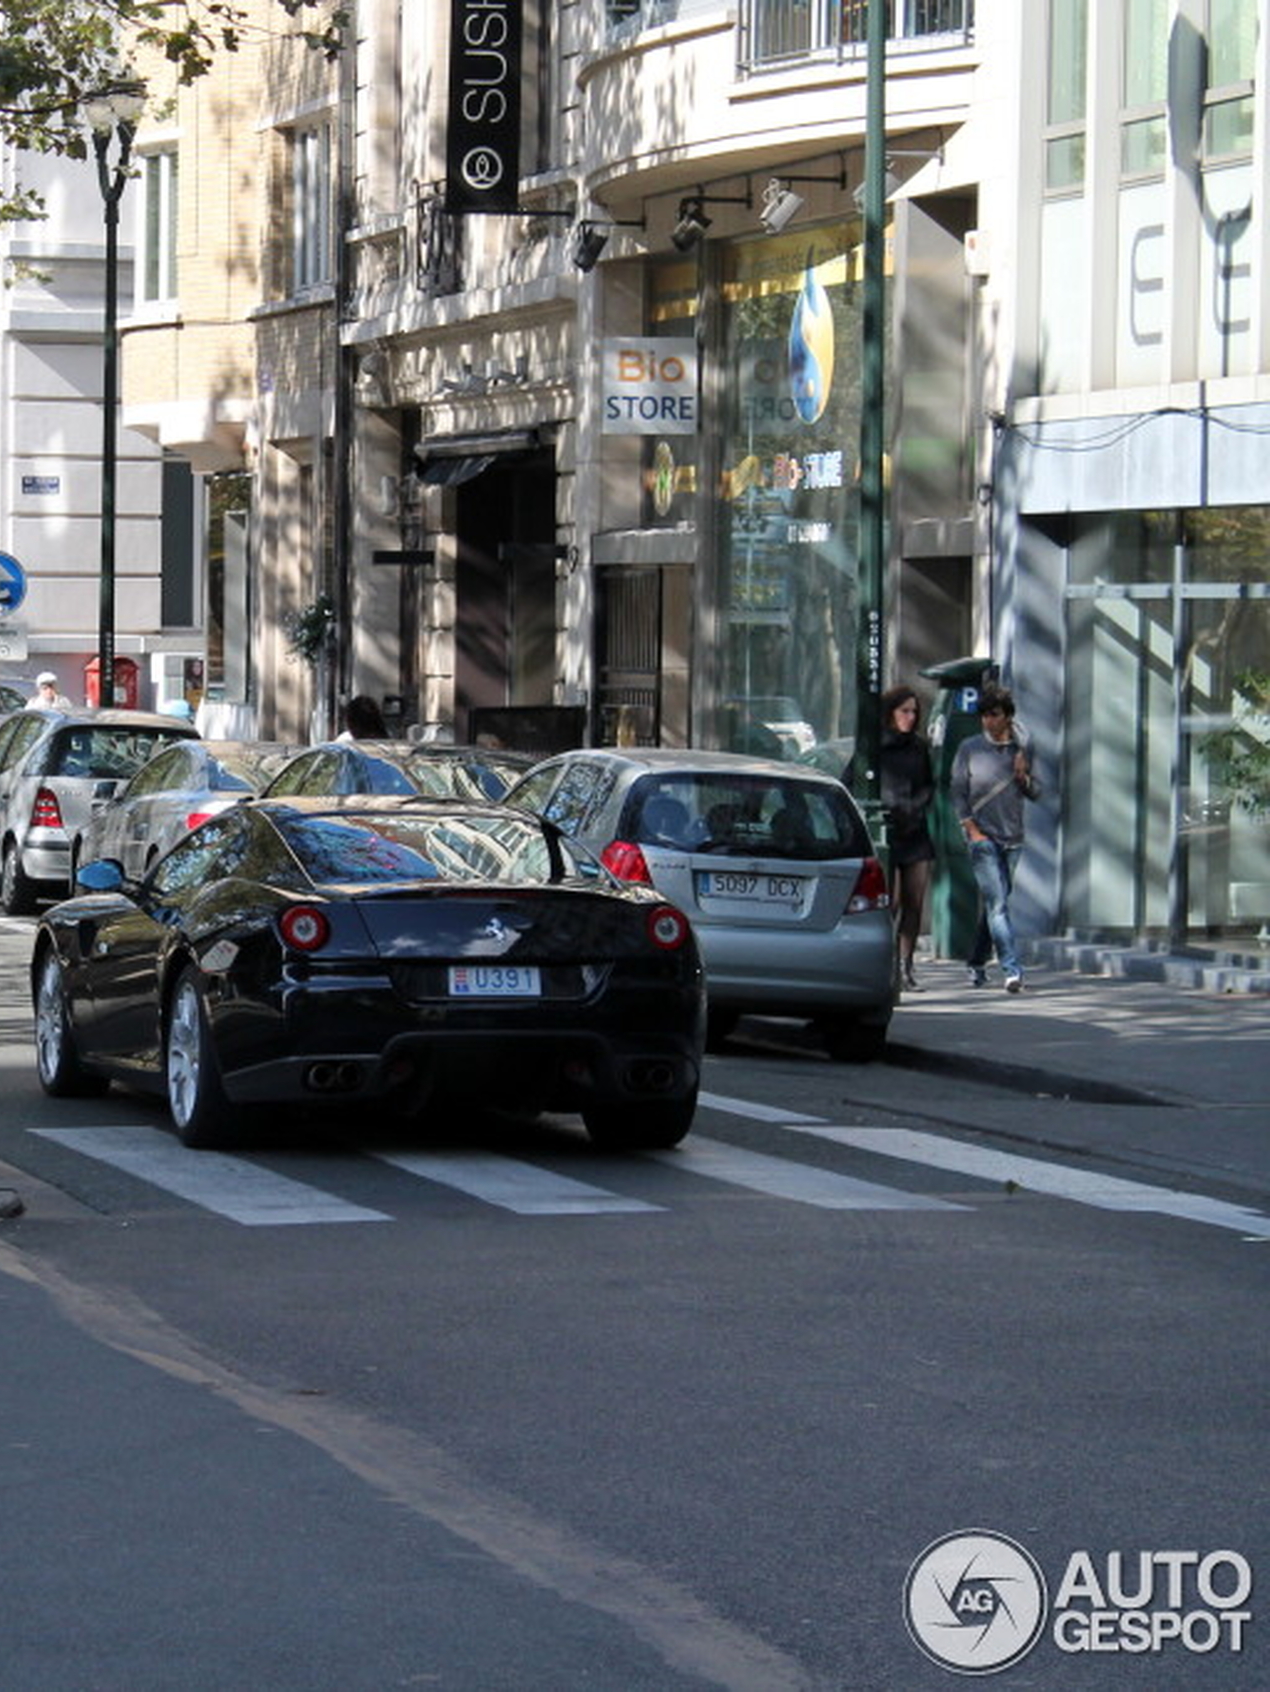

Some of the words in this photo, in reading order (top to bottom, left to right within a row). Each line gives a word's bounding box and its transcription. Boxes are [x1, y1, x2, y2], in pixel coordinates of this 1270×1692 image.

[463, 0, 507, 122] SUS
[618, 350, 685, 382] Bio
[607, 396, 694, 420] STORE
[962, 686, 978, 712] P
[768, 877, 800, 898] DCX
[475, 968, 532, 989] U391
